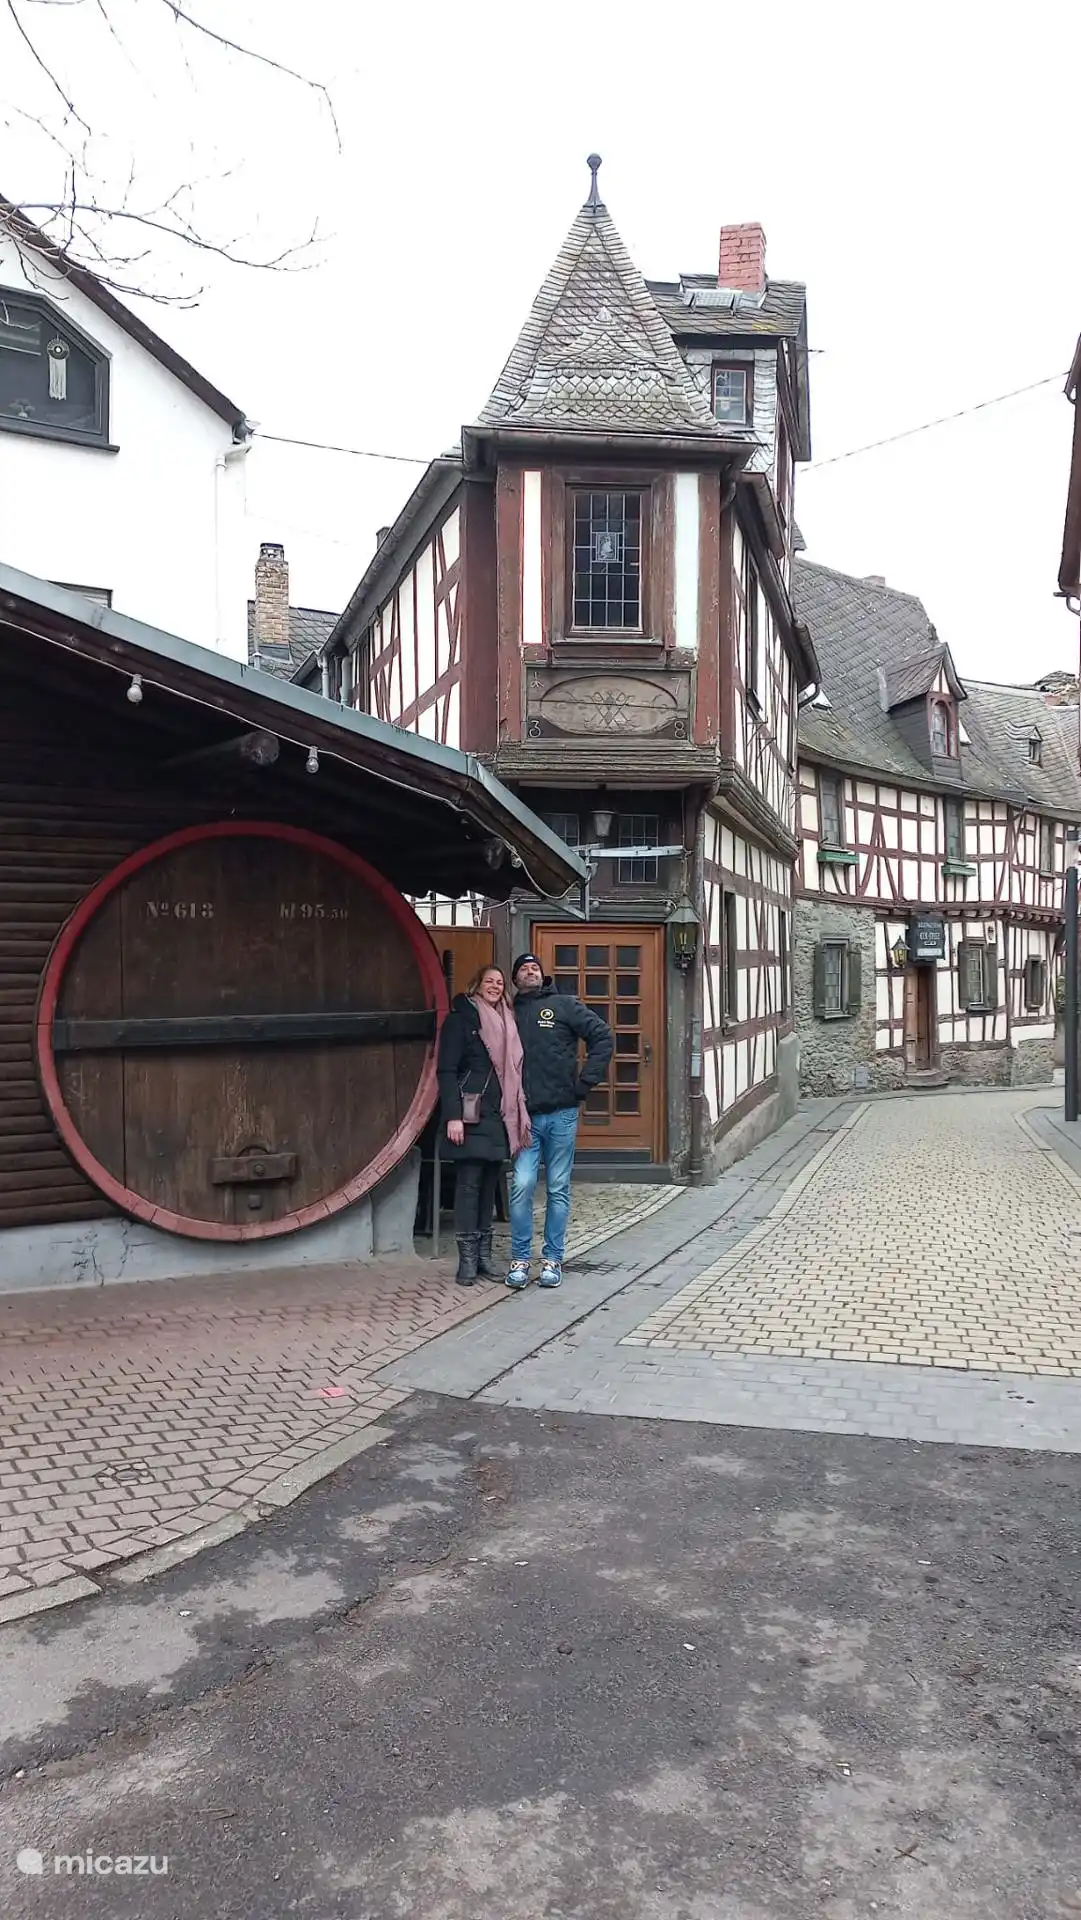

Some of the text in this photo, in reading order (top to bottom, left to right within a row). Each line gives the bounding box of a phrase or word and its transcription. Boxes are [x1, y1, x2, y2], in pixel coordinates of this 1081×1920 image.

[529, 719, 541, 738] 3
[674, 720, 686, 739] 8
[173, 902, 214, 919] 613
